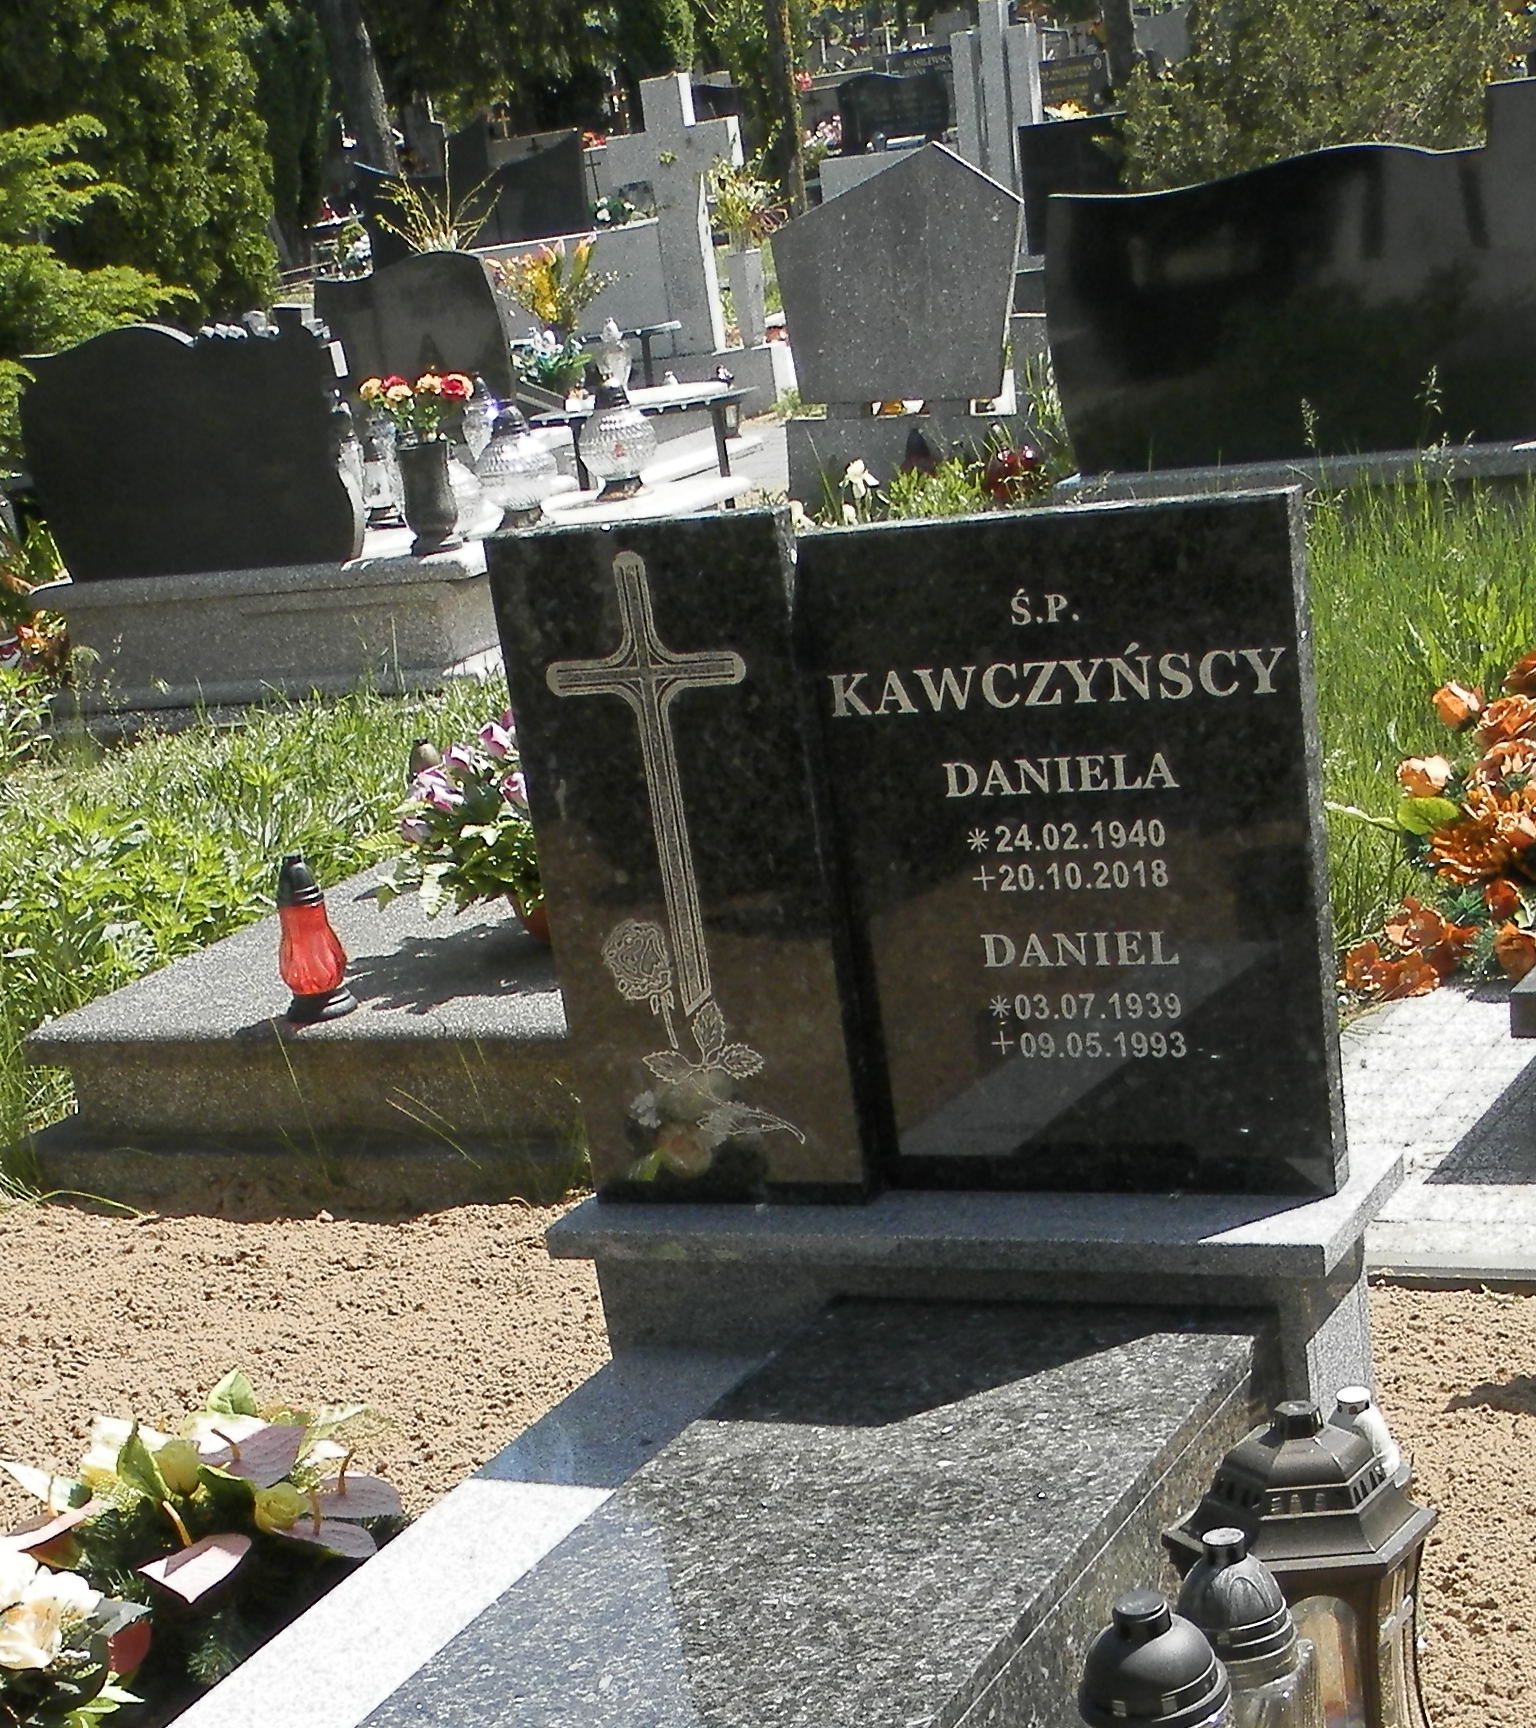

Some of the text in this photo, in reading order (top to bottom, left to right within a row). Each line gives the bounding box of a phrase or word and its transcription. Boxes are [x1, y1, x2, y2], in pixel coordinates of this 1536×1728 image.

[1010, 588, 1080, 626] Ś.P.
[827, 641, 1287, 718] KAWCZYŃSCY
[942, 752, 1181, 798] DANIELA
[980, 930, 1180, 968] DANIEL
